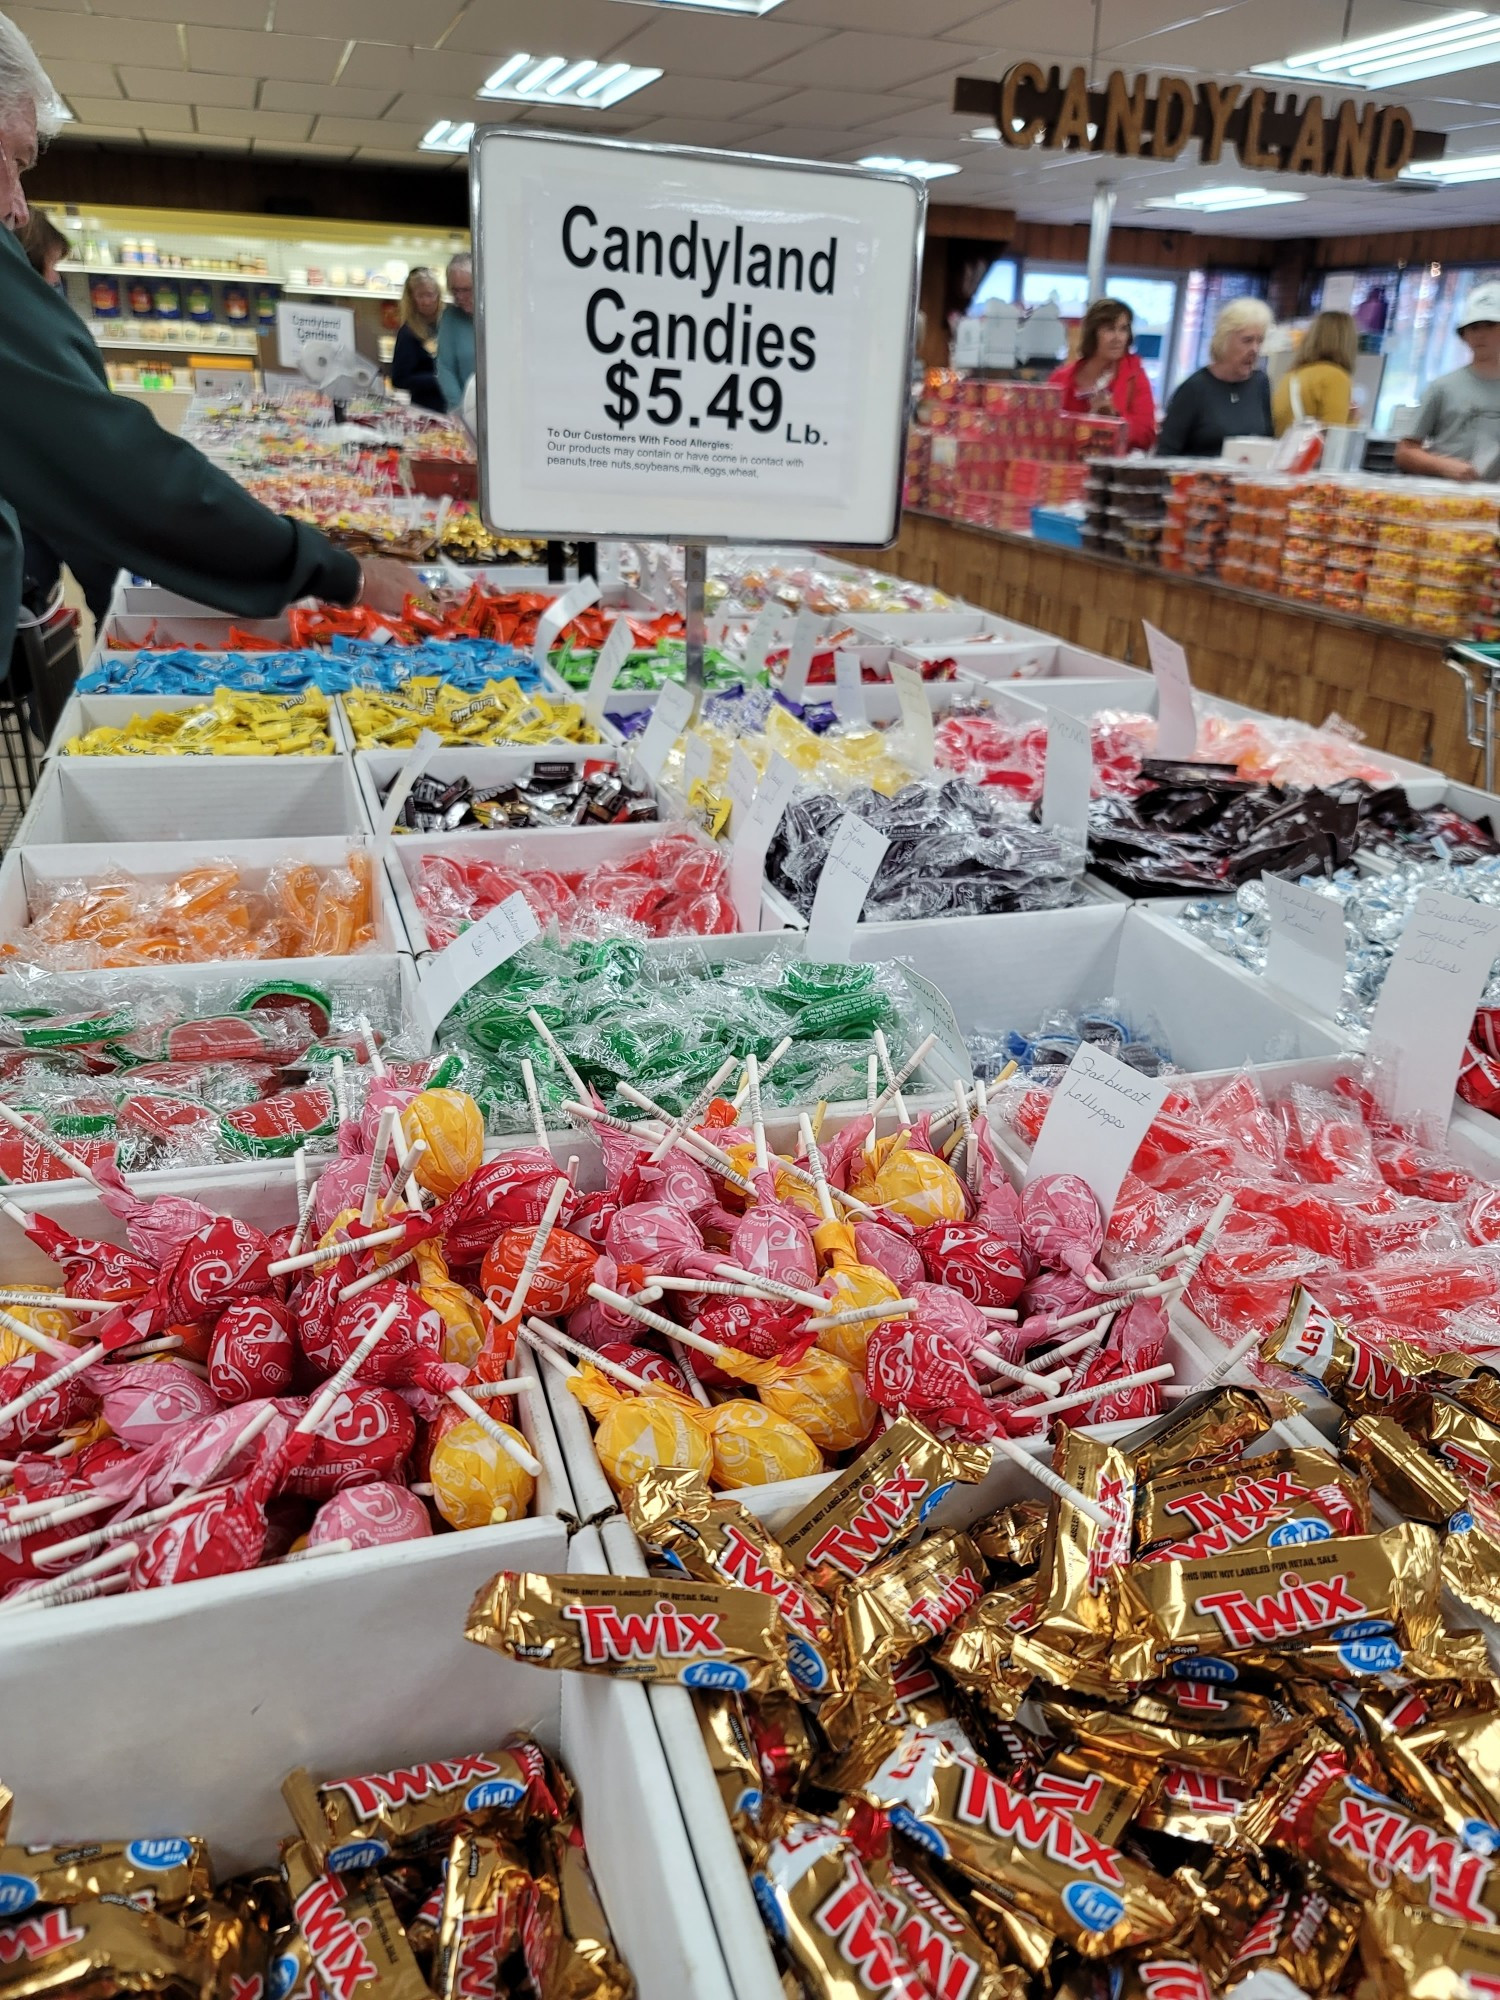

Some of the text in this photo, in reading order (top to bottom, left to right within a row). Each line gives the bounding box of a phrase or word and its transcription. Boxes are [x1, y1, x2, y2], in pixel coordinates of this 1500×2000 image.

[1000, 61, 1414, 181] CANDYLAND
[561, 205, 838, 299] Candyland
[585, 288, 817, 372] Candies
[603, 359, 829, 446] $5.49 Lb.
[547, 428, 733, 450] To Our Customers With Food Allergies:
[547, 441, 804, 468] Our products may contain or have come in contact with
[547, 456, 607, 470] peanuts,tree
[1070, 1056, 1151, 1106] Starburst
[225, 1107, 275, 1161] PIZAZZ
[262, 1105, 292, 1141] JUICY JELLIES
[264, 1094, 308, 1143] PIZAZZ
[92, 1140, 100, 1166] ELLIES
[192, 1249, 224, 1264] cherry
[1380, 1236, 1402, 1248] JUICY
[1398, 1289, 1421, 1298] CANADA
[170, 1373, 211, 1409] strawberry
[390, 1401, 400, 1435] cherry
[1078, 1464, 1087, 1483] SALE
[1151, 1484, 1167, 1494] THIS
[1167, 1481, 1182, 1491] UNIT
[1183, 1478, 1197, 1488] NOT
[1197, 1472, 1226, 1485] LABELED
[1227, 1470, 1240, 1481] FOR
[1241, 1465, 1262, 1477] RETAIL
[784, 1447, 895, 1549] THIS UNIT NOT LABELED FOR RETAIL SALE
[1164, 1471, 1311, 1532] Twix
[373, 1508, 415, 1536] strawberry
[807, 1463, 929, 1578] Twix
[717, 1522, 829, 1646] Twix
[1182, 1554, 1339, 1581] THIS UNIT NOT LABELED FOR RETAIL SALE
[581, 1588, 599, 1597] UNIT
[600, 1588, 617, 1597] NOT
[906, 1567, 985, 1637] Twix
[1194, 1571, 1367, 1650] Twix
[562, 1599, 728, 1665] Twix
[1351, 1639, 1394, 1662] fun
[691, 1664, 739, 1686] fun
[787, 1634, 821, 1678] fun
[320, 1752, 501, 1822] Twix
[476, 1783, 516, 1805] fun
[955, 1753, 1126, 1888] Twix
[1329, 1796, 1498, 1926] Twix
[1074, 1887, 1123, 1926] fun
